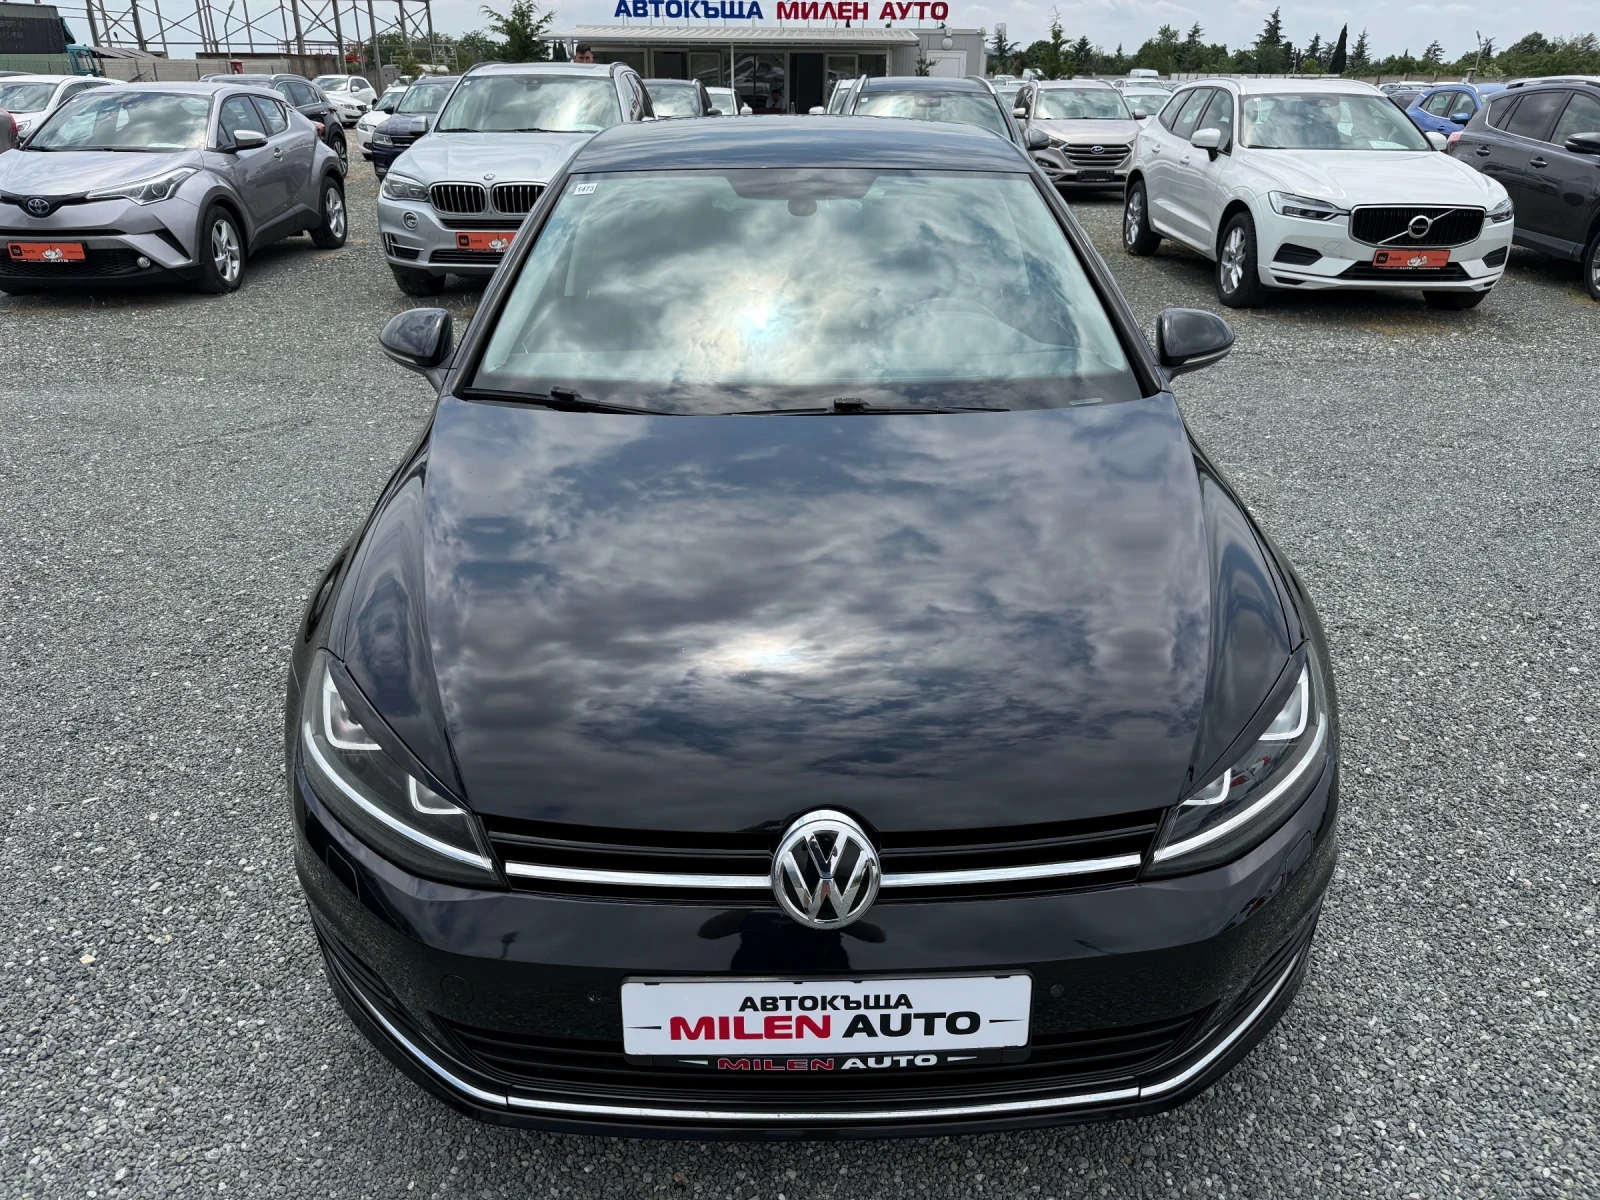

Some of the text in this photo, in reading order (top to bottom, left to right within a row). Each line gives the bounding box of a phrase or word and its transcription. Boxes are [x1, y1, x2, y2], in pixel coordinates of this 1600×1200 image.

[614, 0, 949, 20] АВТОКЪЩА МИЛЕН АУТО
[738, 993, 914, 1012] АВТОКЪЩА
[669, 1011, 981, 1041] MILEN AUTO
[717, 1054, 938, 1071] MILEN AUTO
